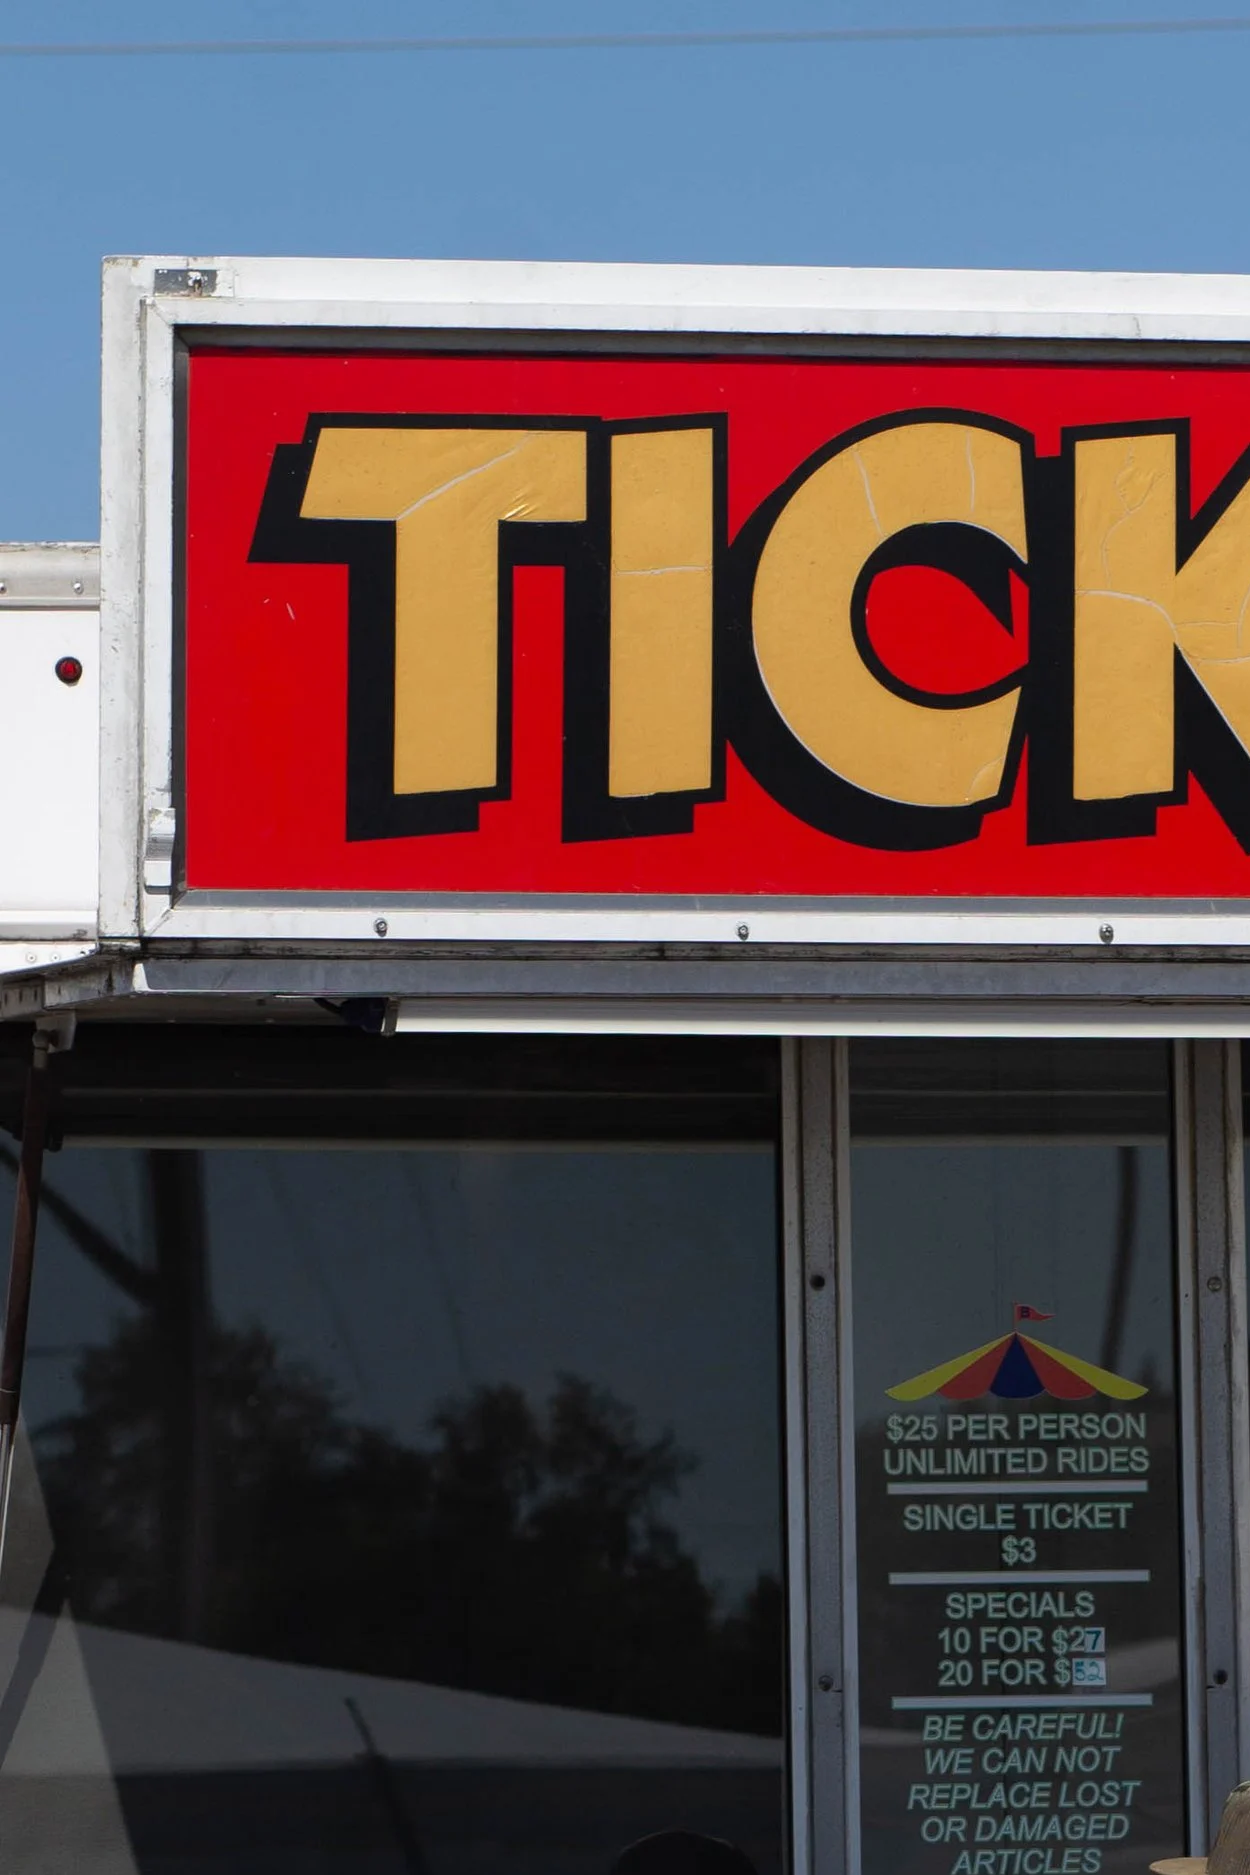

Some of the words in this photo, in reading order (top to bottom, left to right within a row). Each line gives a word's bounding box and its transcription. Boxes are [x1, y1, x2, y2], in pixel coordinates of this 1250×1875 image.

[886, 1413, 938, 1442] $25
[947, 1414, 1009, 1441] PER
[1018, 1413, 1147, 1441] PERSON
[884, 1447, 1048, 1475] UNLIMITED
[1057, 1446, 1150, 1474] RIDES
[904, 1504, 1016, 1531] SINGLE
[1022, 1502, 1133, 1529] TICKET
[1001, 1536, 1036, 1565] $3
[945, 1591, 1095, 1619] SPECIALS
[938, 1628, 971, 1655] 10
[980, 1627, 1046, 1654] FOR
[1051, 1626, 1104, 1657] $27
[938, 1661, 973, 1687] 20
[982, 1659, 1047, 1686] FOR
[923, 1715, 964, 1741] BE
[972, 1713, 1125, 1741] CAREFUL!
[925, 1748, 974, 1775] WE
[982, 1747, 1046, 1774] CAN
[1054, 1746, 1121, 1772] NOT
[907, 1782, 1051, 1810] REPLACE
[1058, 1780, 1141, 1808] LOST
[920, 1816, 967, 1843] OR
[975, 1813, 1130, 1842] DAMAGED
[951, 1848, 1102, 1875] ARTICLES
